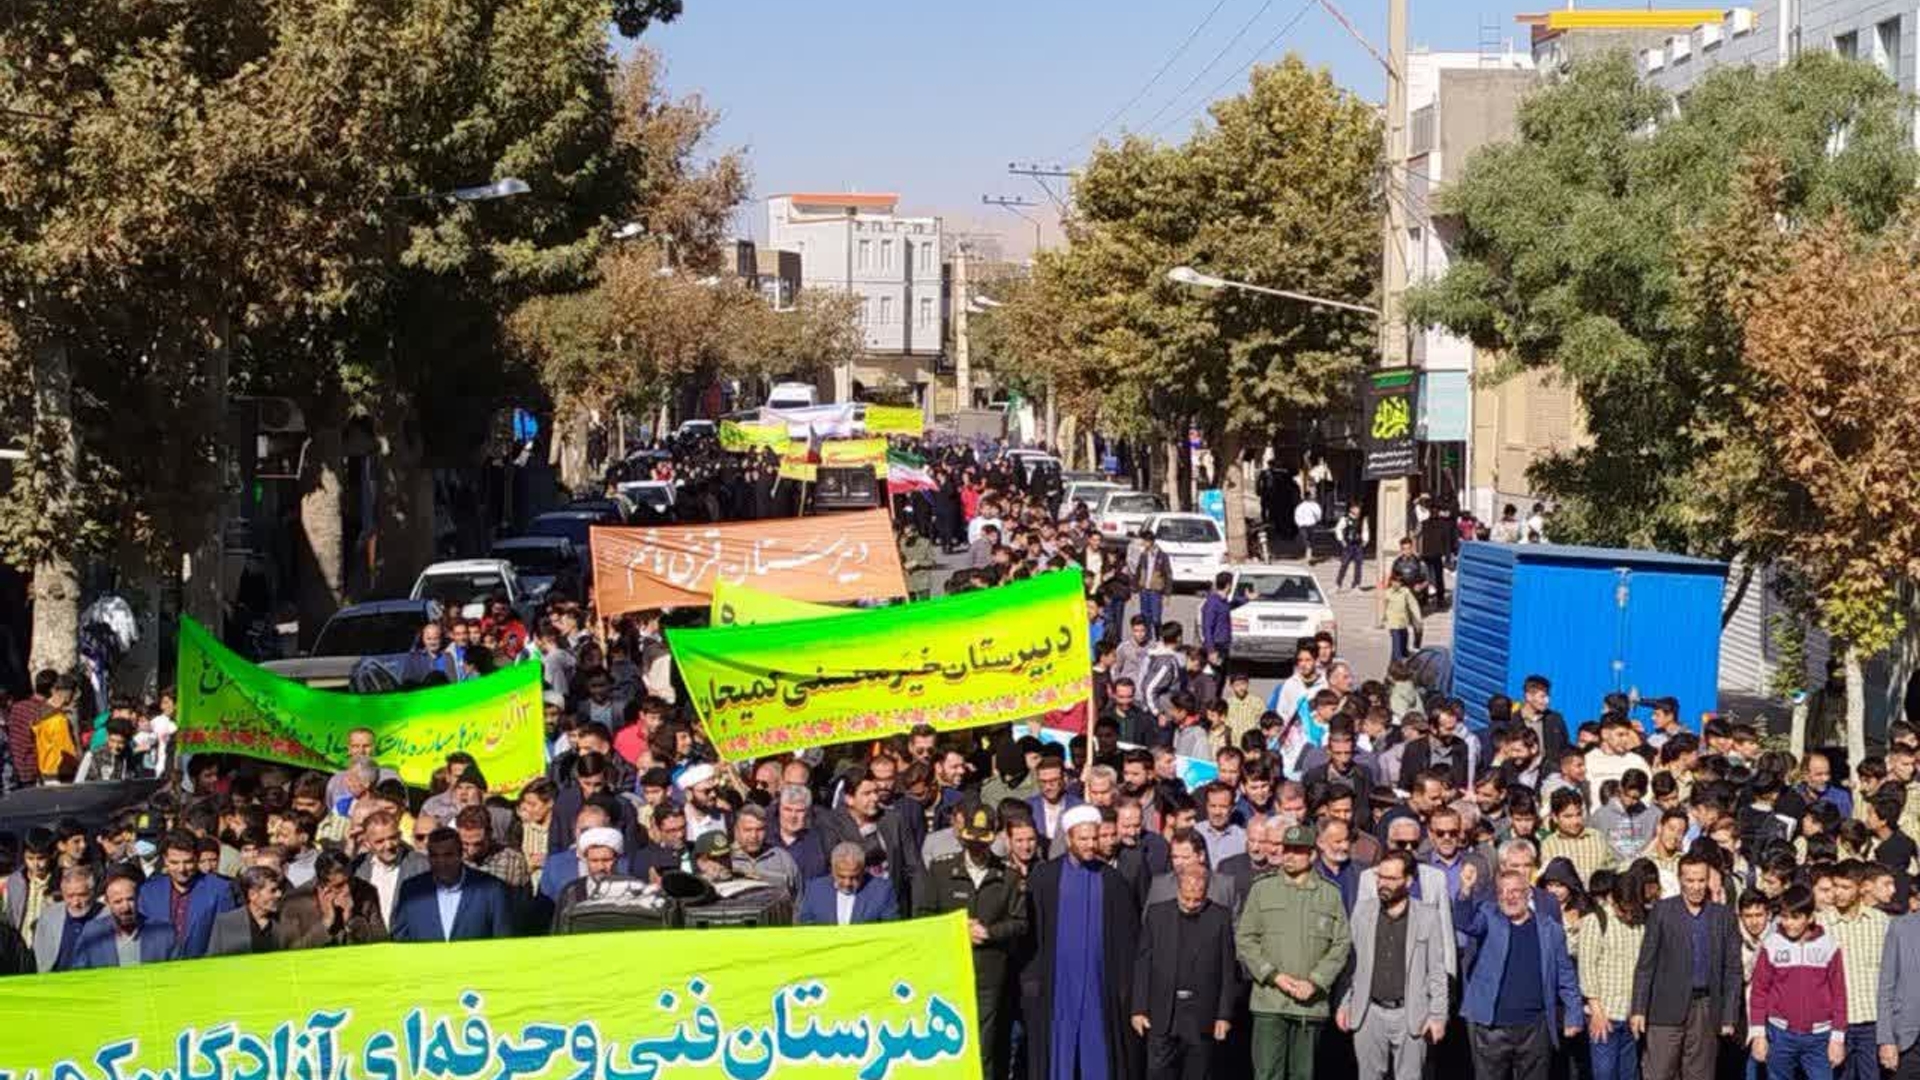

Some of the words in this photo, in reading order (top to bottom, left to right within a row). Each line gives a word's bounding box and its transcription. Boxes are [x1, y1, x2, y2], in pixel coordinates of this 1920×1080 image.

[717, 534, 869, 587] دبیرستان
[940, 625, 1072, 680] دبیرستان
[603, 977, 722, 1080] فنی
[722, 982, 966, 1080] هنرستان
